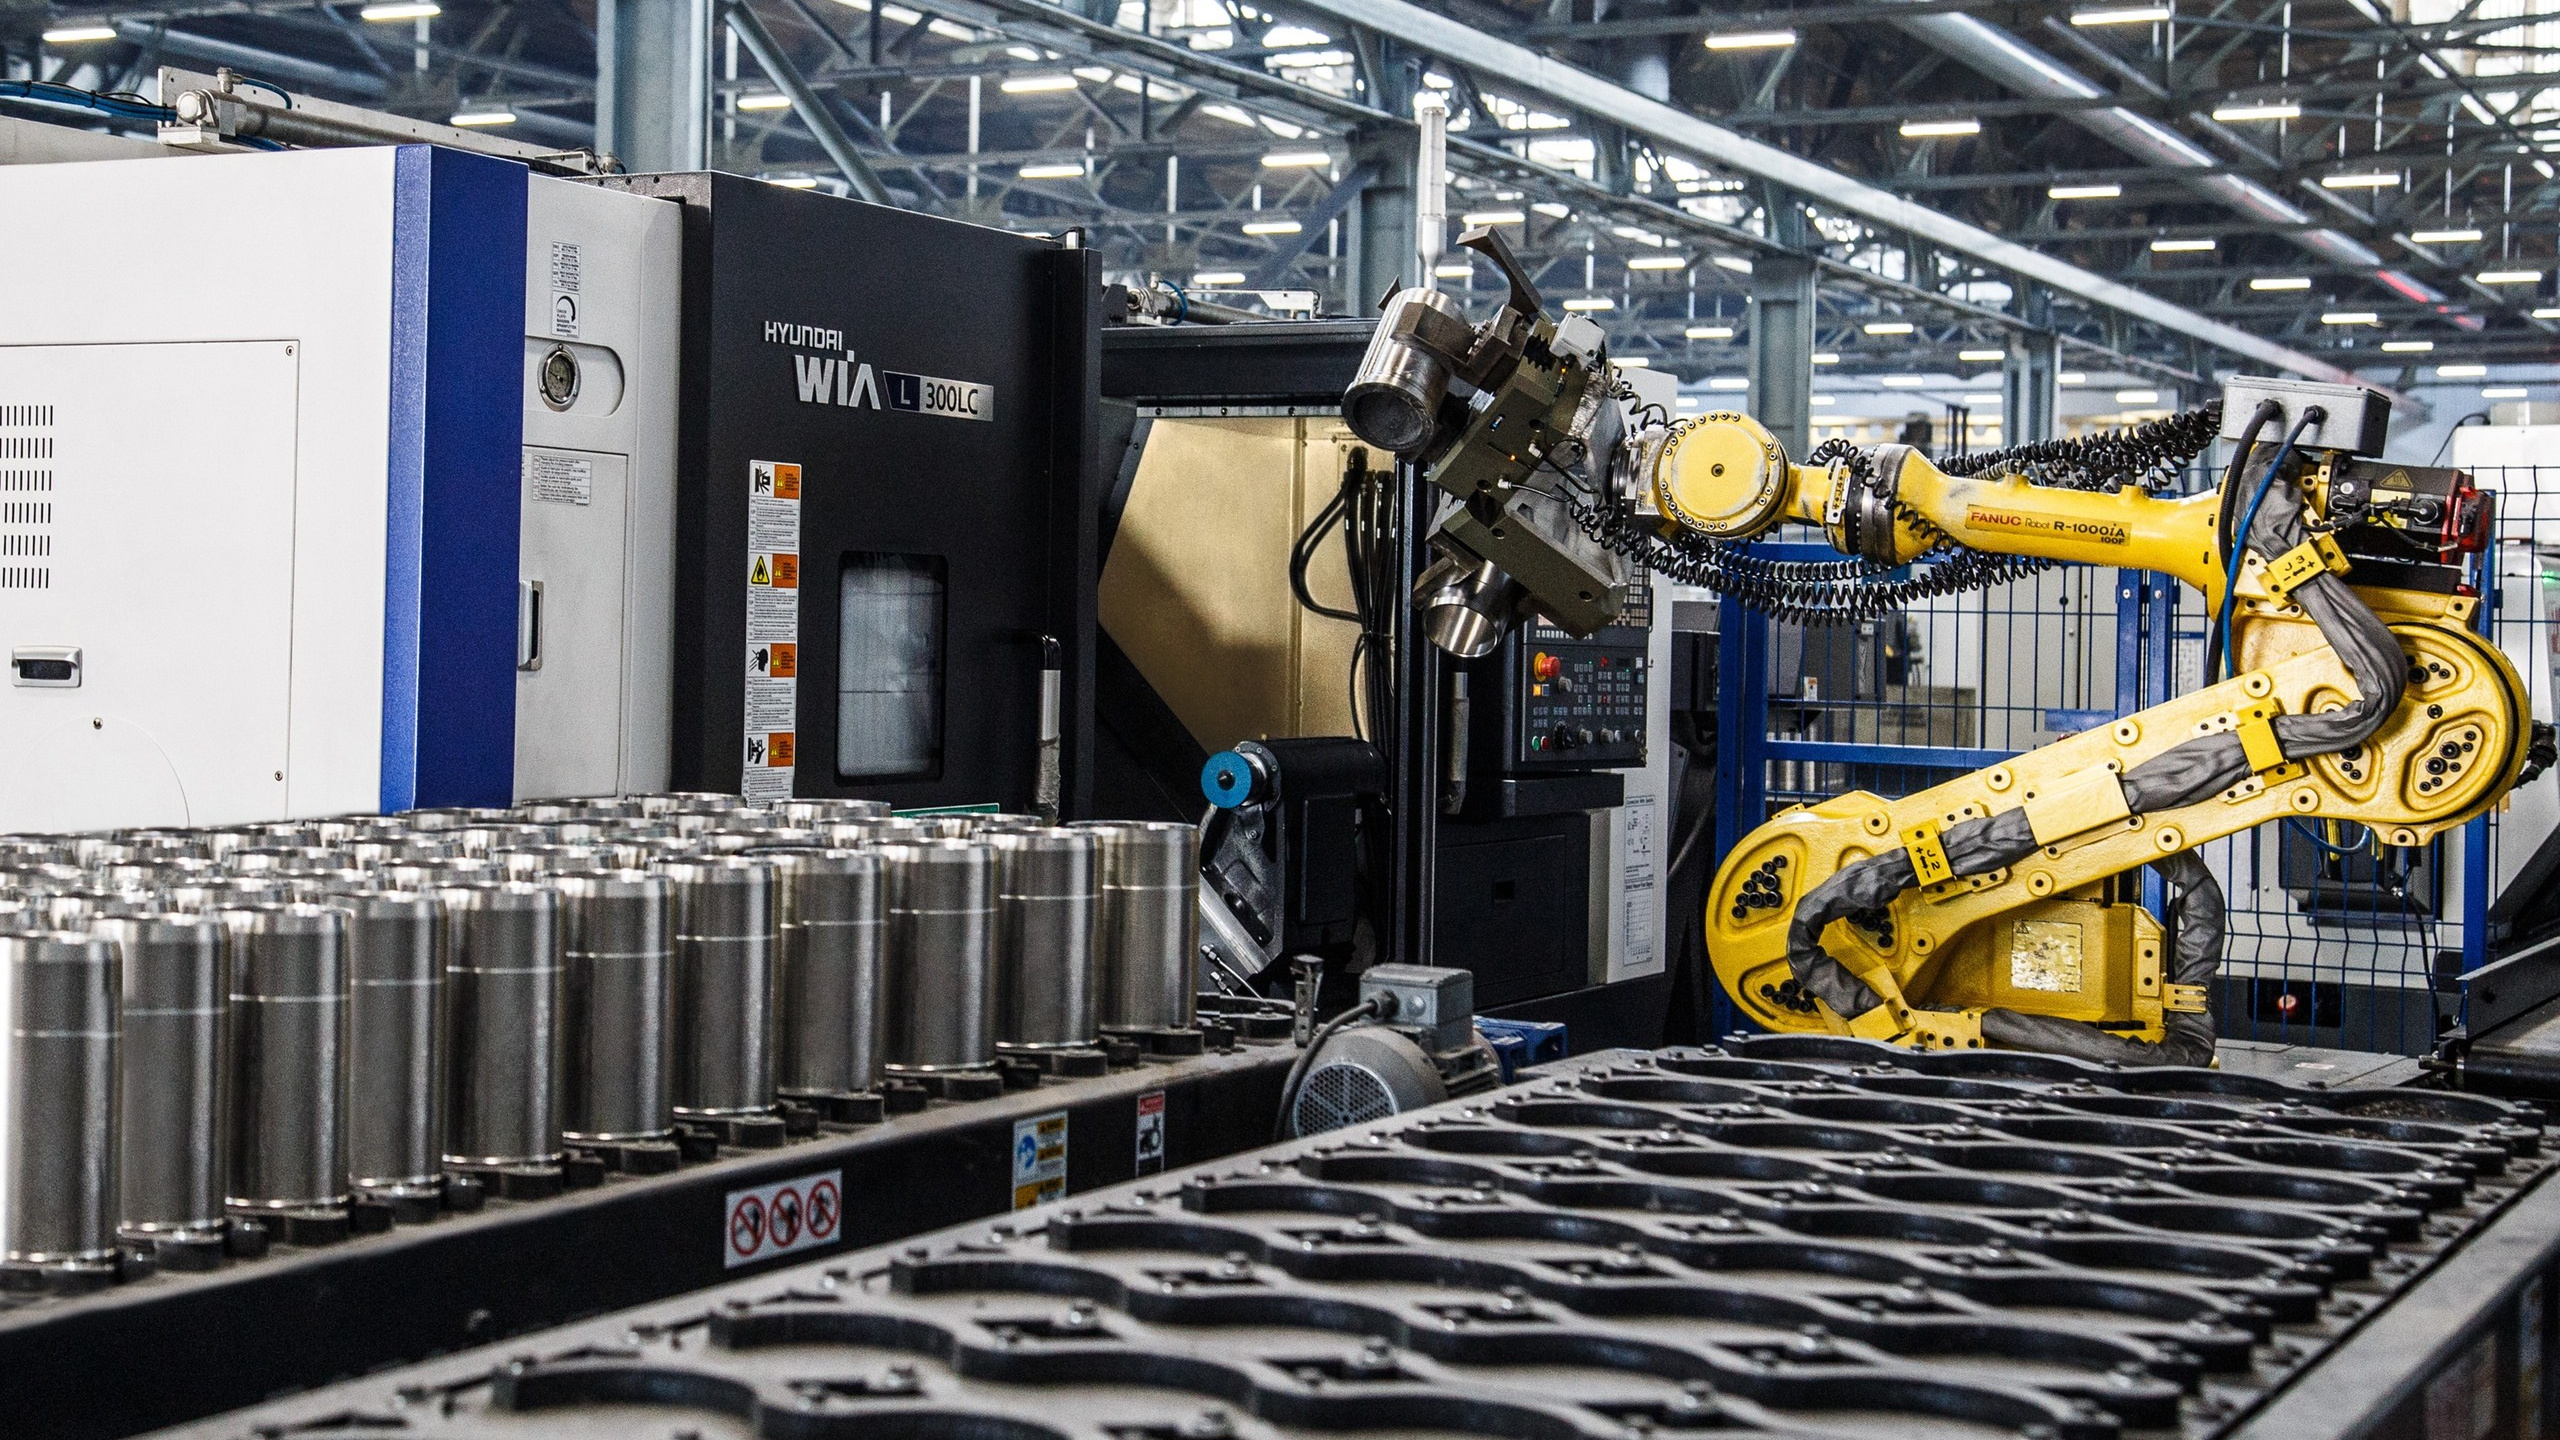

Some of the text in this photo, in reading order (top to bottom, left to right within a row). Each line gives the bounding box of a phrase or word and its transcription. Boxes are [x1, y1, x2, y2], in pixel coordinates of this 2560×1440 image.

[765, 320, 842, 351] HYUNDAI
[900, 379, 911, 405] L
[925, 382, 979, 415] 300LC
[1970, 512, 2125, 537] FANUC Robot R-1000iA
[2100, 536, 2125, 545] 100F
